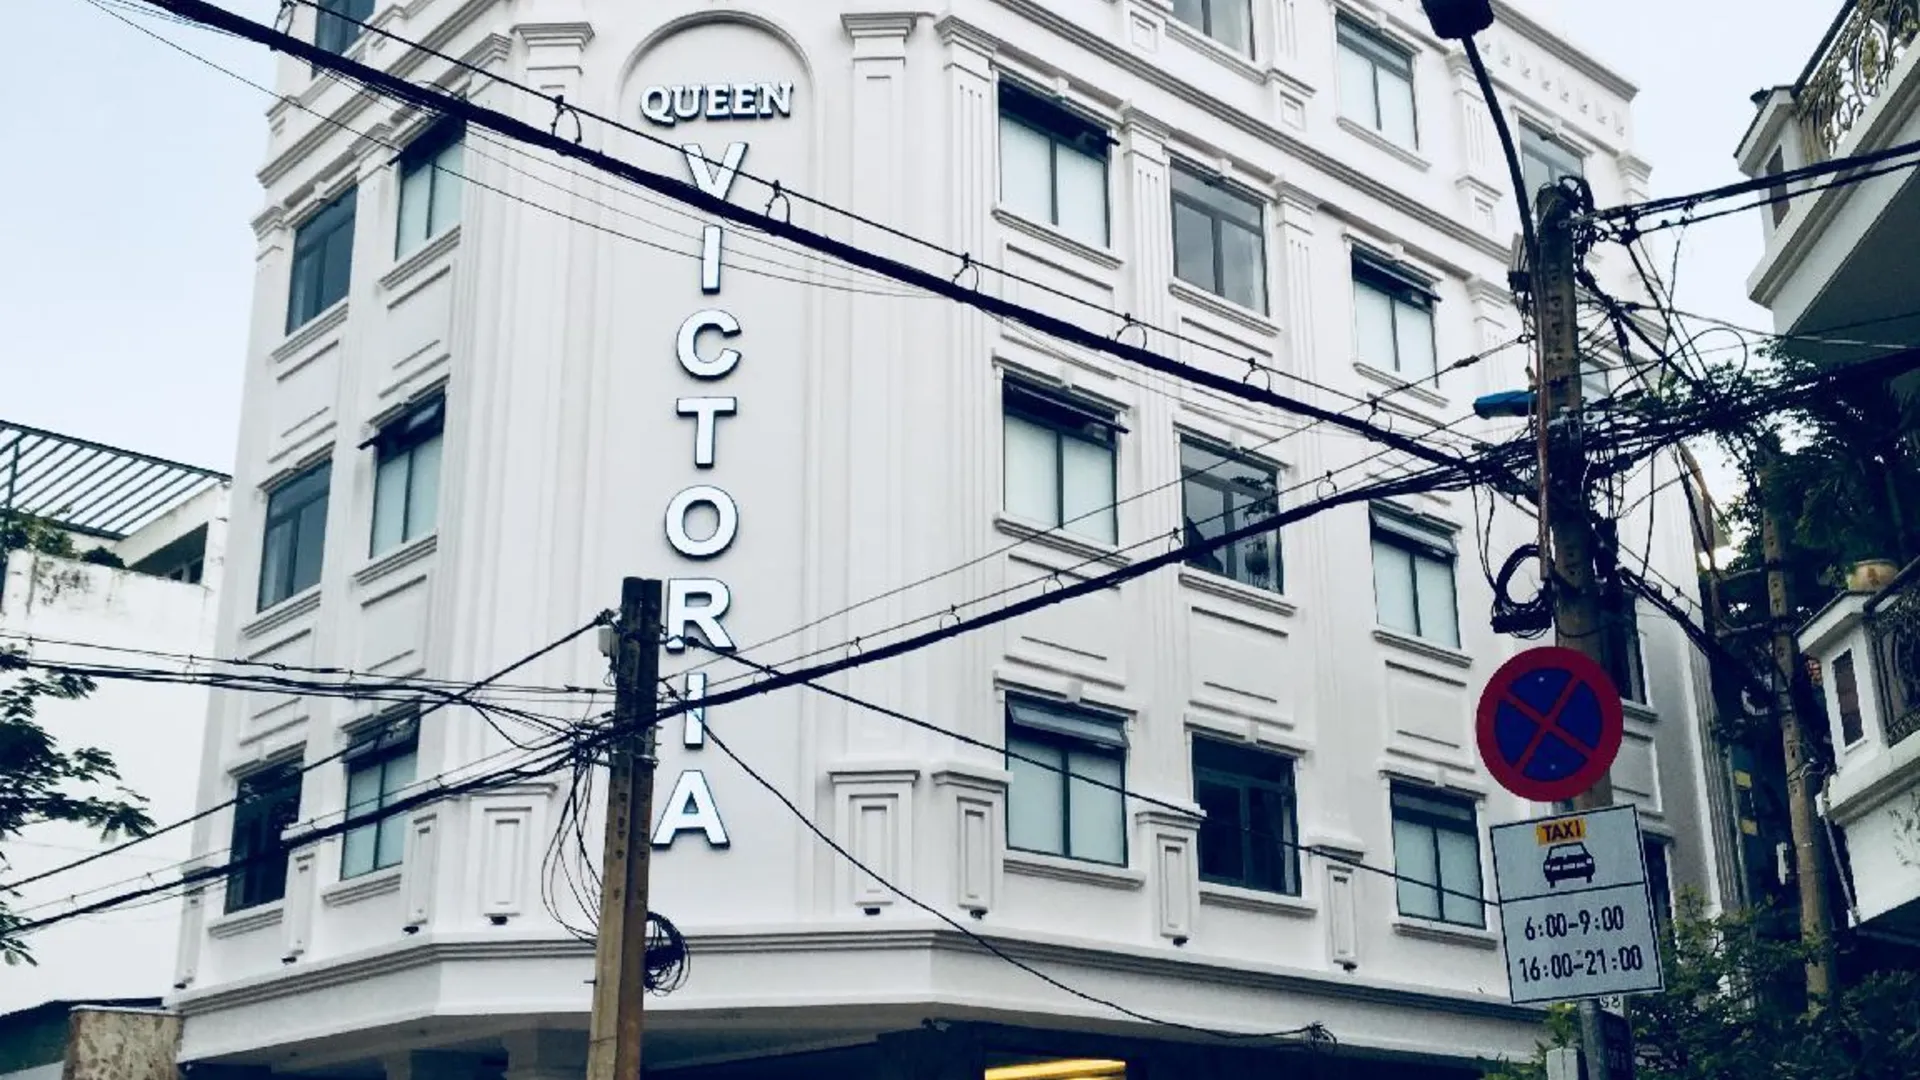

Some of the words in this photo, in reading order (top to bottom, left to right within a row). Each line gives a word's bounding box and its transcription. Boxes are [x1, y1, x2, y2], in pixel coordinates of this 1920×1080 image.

[639, 82, 793, 126] QUEEN
[650, 142, 749, 849] VICTORIA
[1541, 819, 1582, 842] TAXI
[1524, 905, 1625, 941] 6:00-9:00
[1519, 944, 1643, 983] 16:00-21:00
